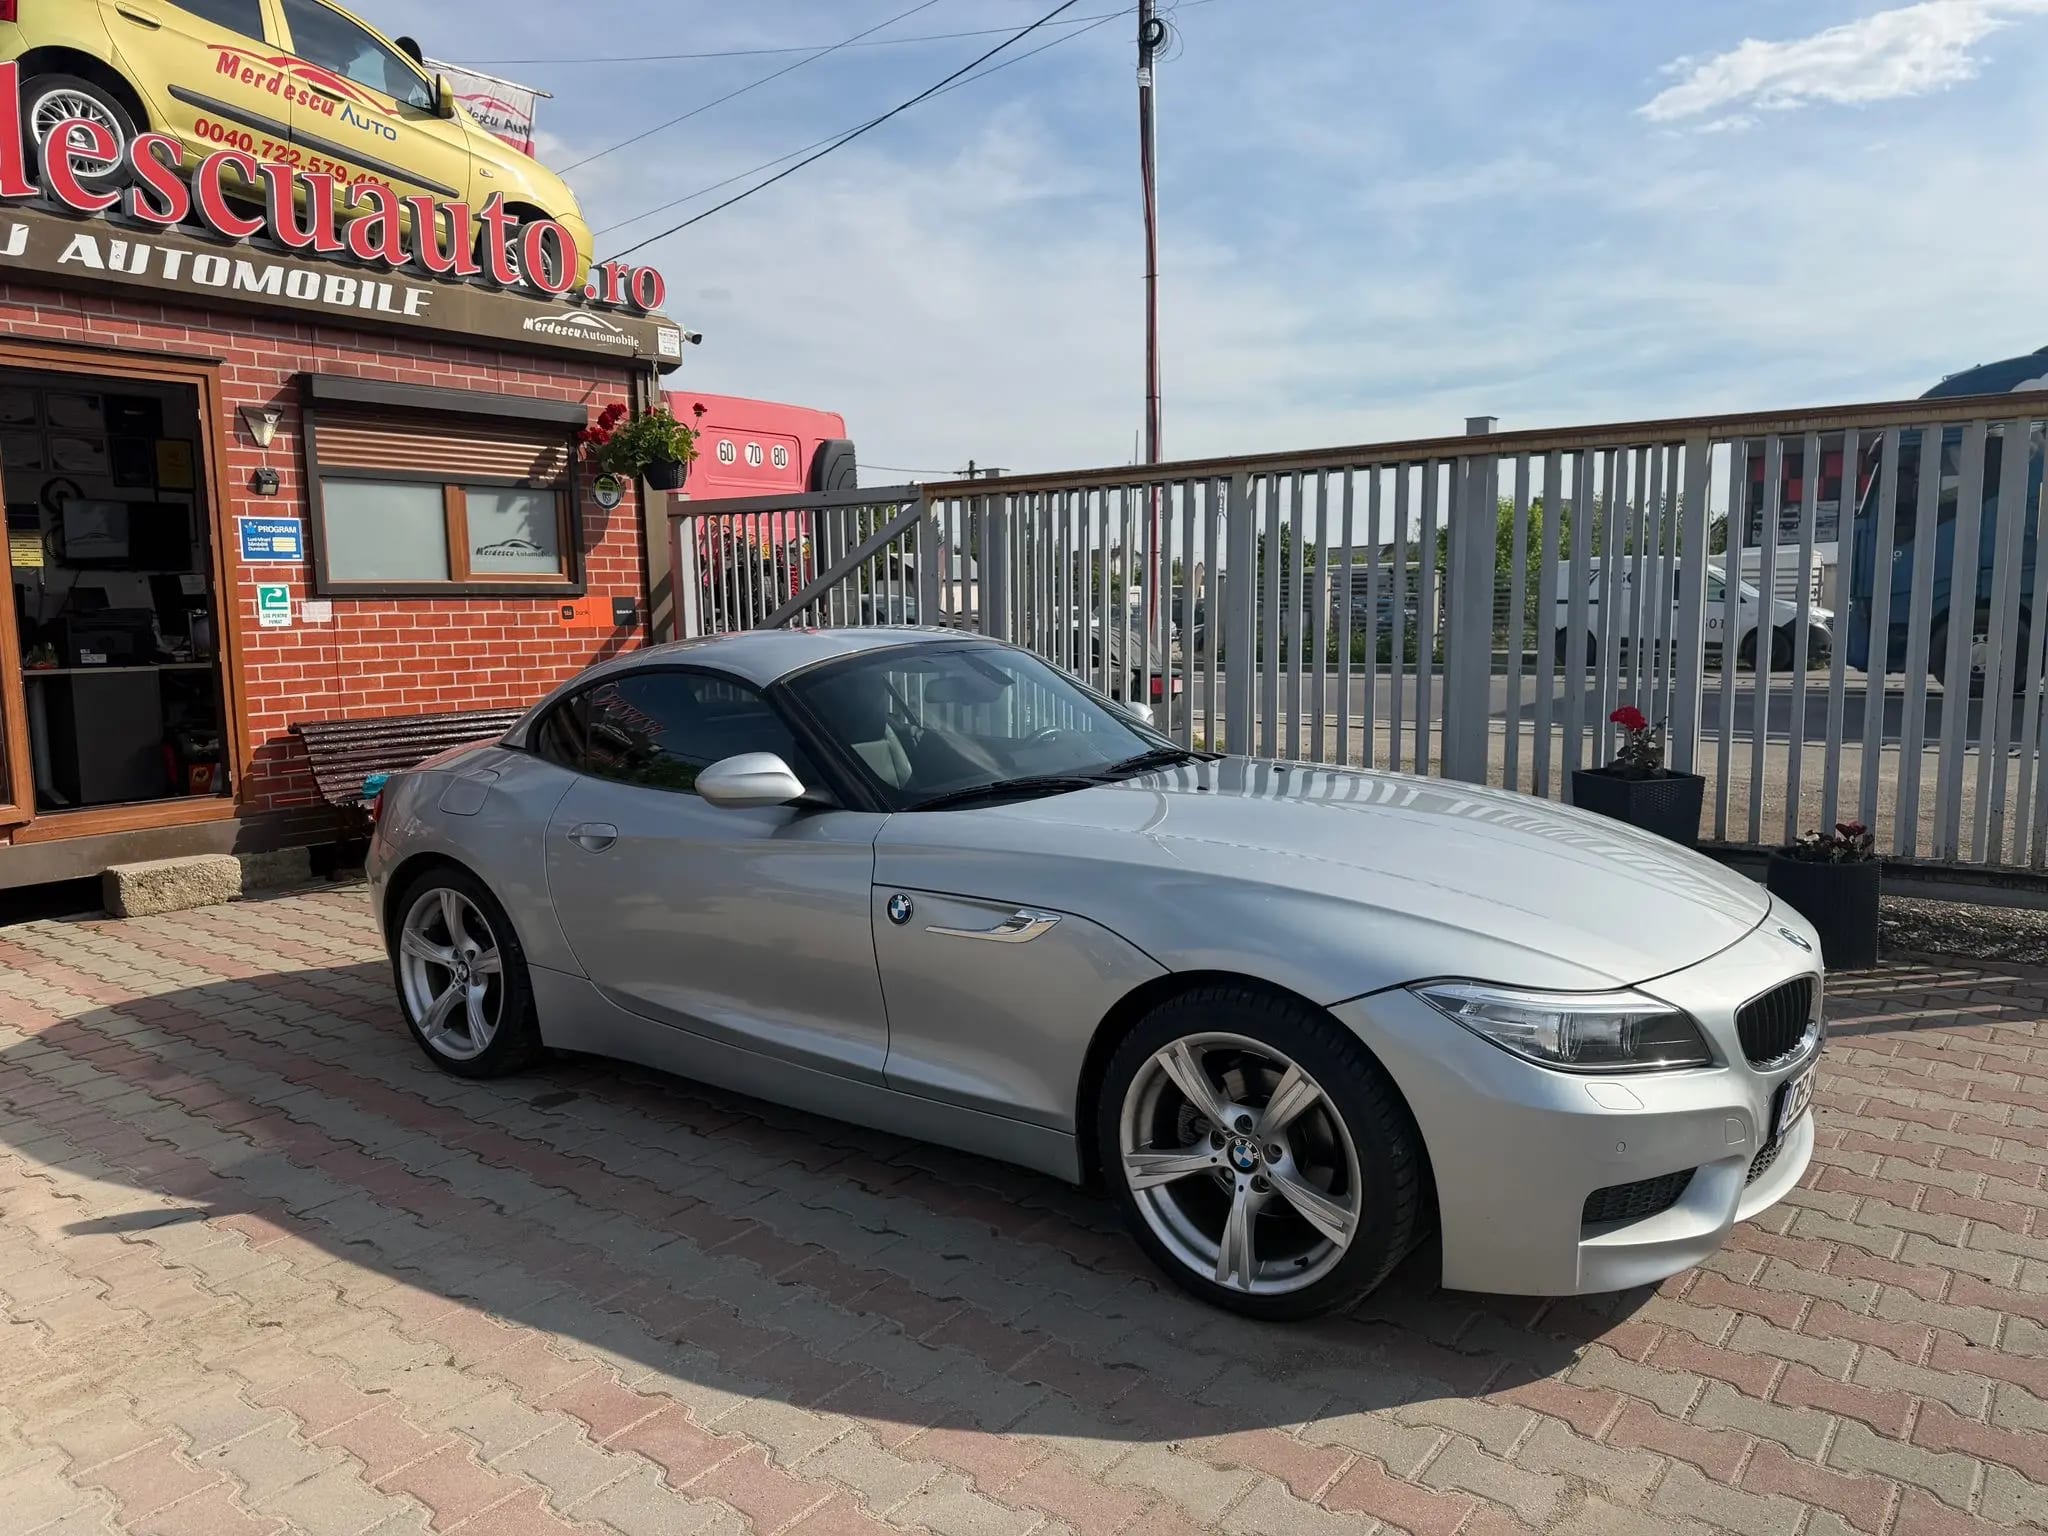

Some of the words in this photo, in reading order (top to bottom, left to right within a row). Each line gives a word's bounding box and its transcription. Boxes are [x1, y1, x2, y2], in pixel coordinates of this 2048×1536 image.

[215, 52, 336, 117] Merdescu
[340, 104, 397, 141] AUTO
[194, 118, 390, 187] 0040.722.579.4
[57, 233, 434, 318] AUTOMOBILE
[523, 317, 581, 338] Merdescu
[581, 328, 640, 347] Automobile
[719, 442, 734, 462] 60
[748, 444, 761, 464] 70
[773, 447, 786, 466] 80
[257, 525, 297, 534] PROGRAM
